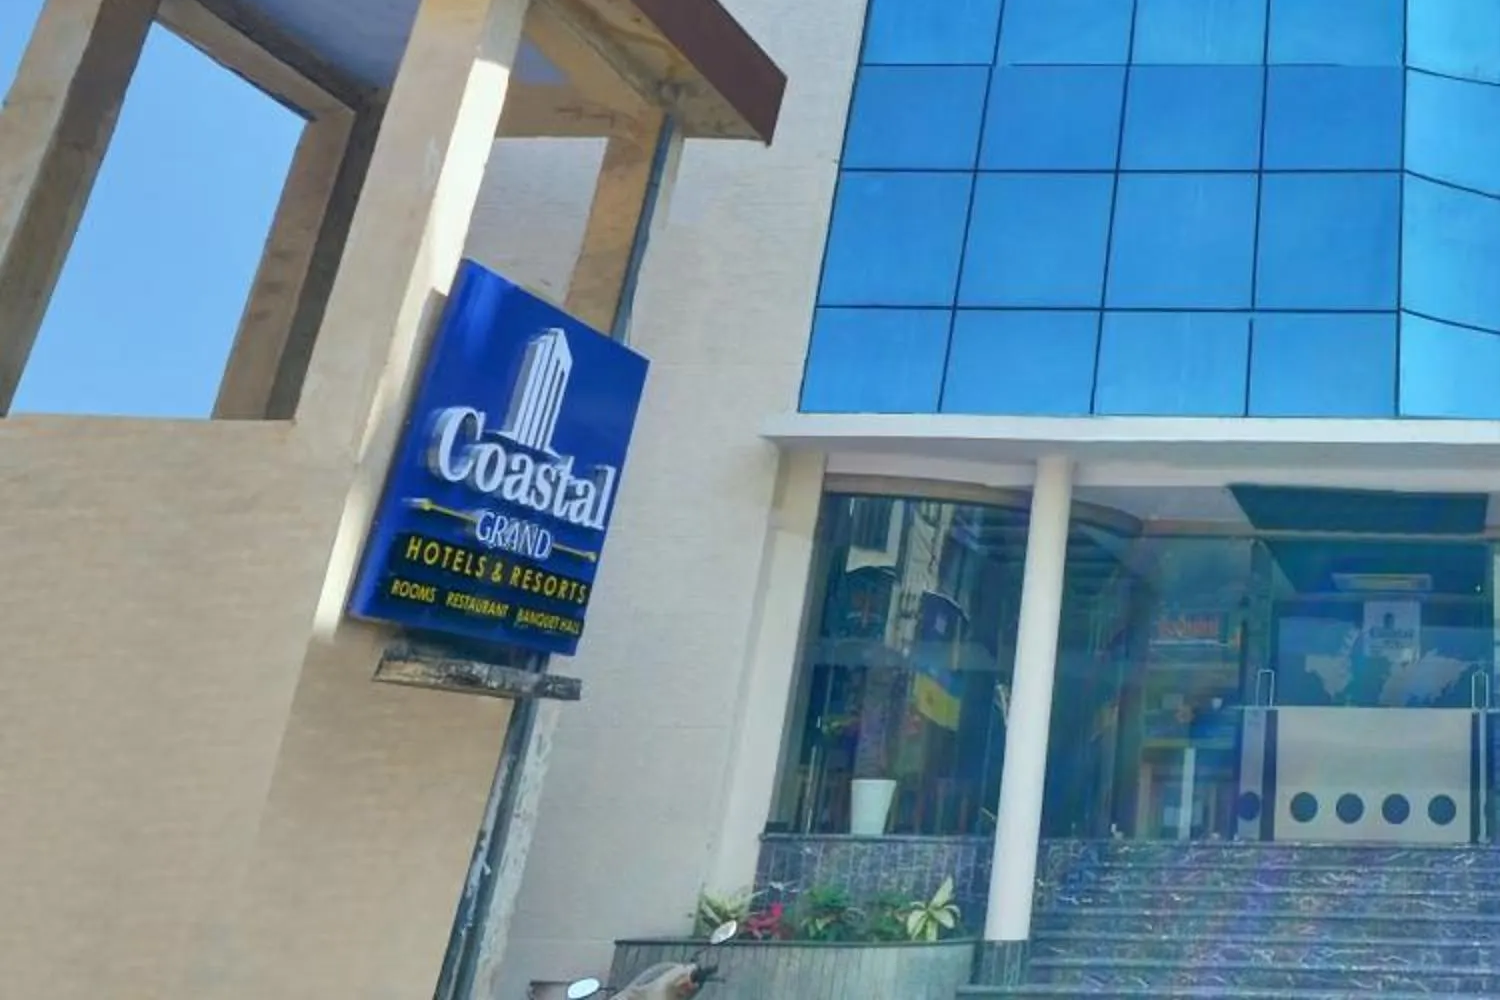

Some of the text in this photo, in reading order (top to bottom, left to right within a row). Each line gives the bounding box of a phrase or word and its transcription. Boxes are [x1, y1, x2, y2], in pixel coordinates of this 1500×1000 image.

[432, 407, 615, 531] Coastal
[474, 511, 553, 560] GRAND
[390, 578, 437, 603] ROOMS
[445, 591, 510, 618] RESTAURANT
[405, 536, 587, 605] HOTELS & RESORTS
